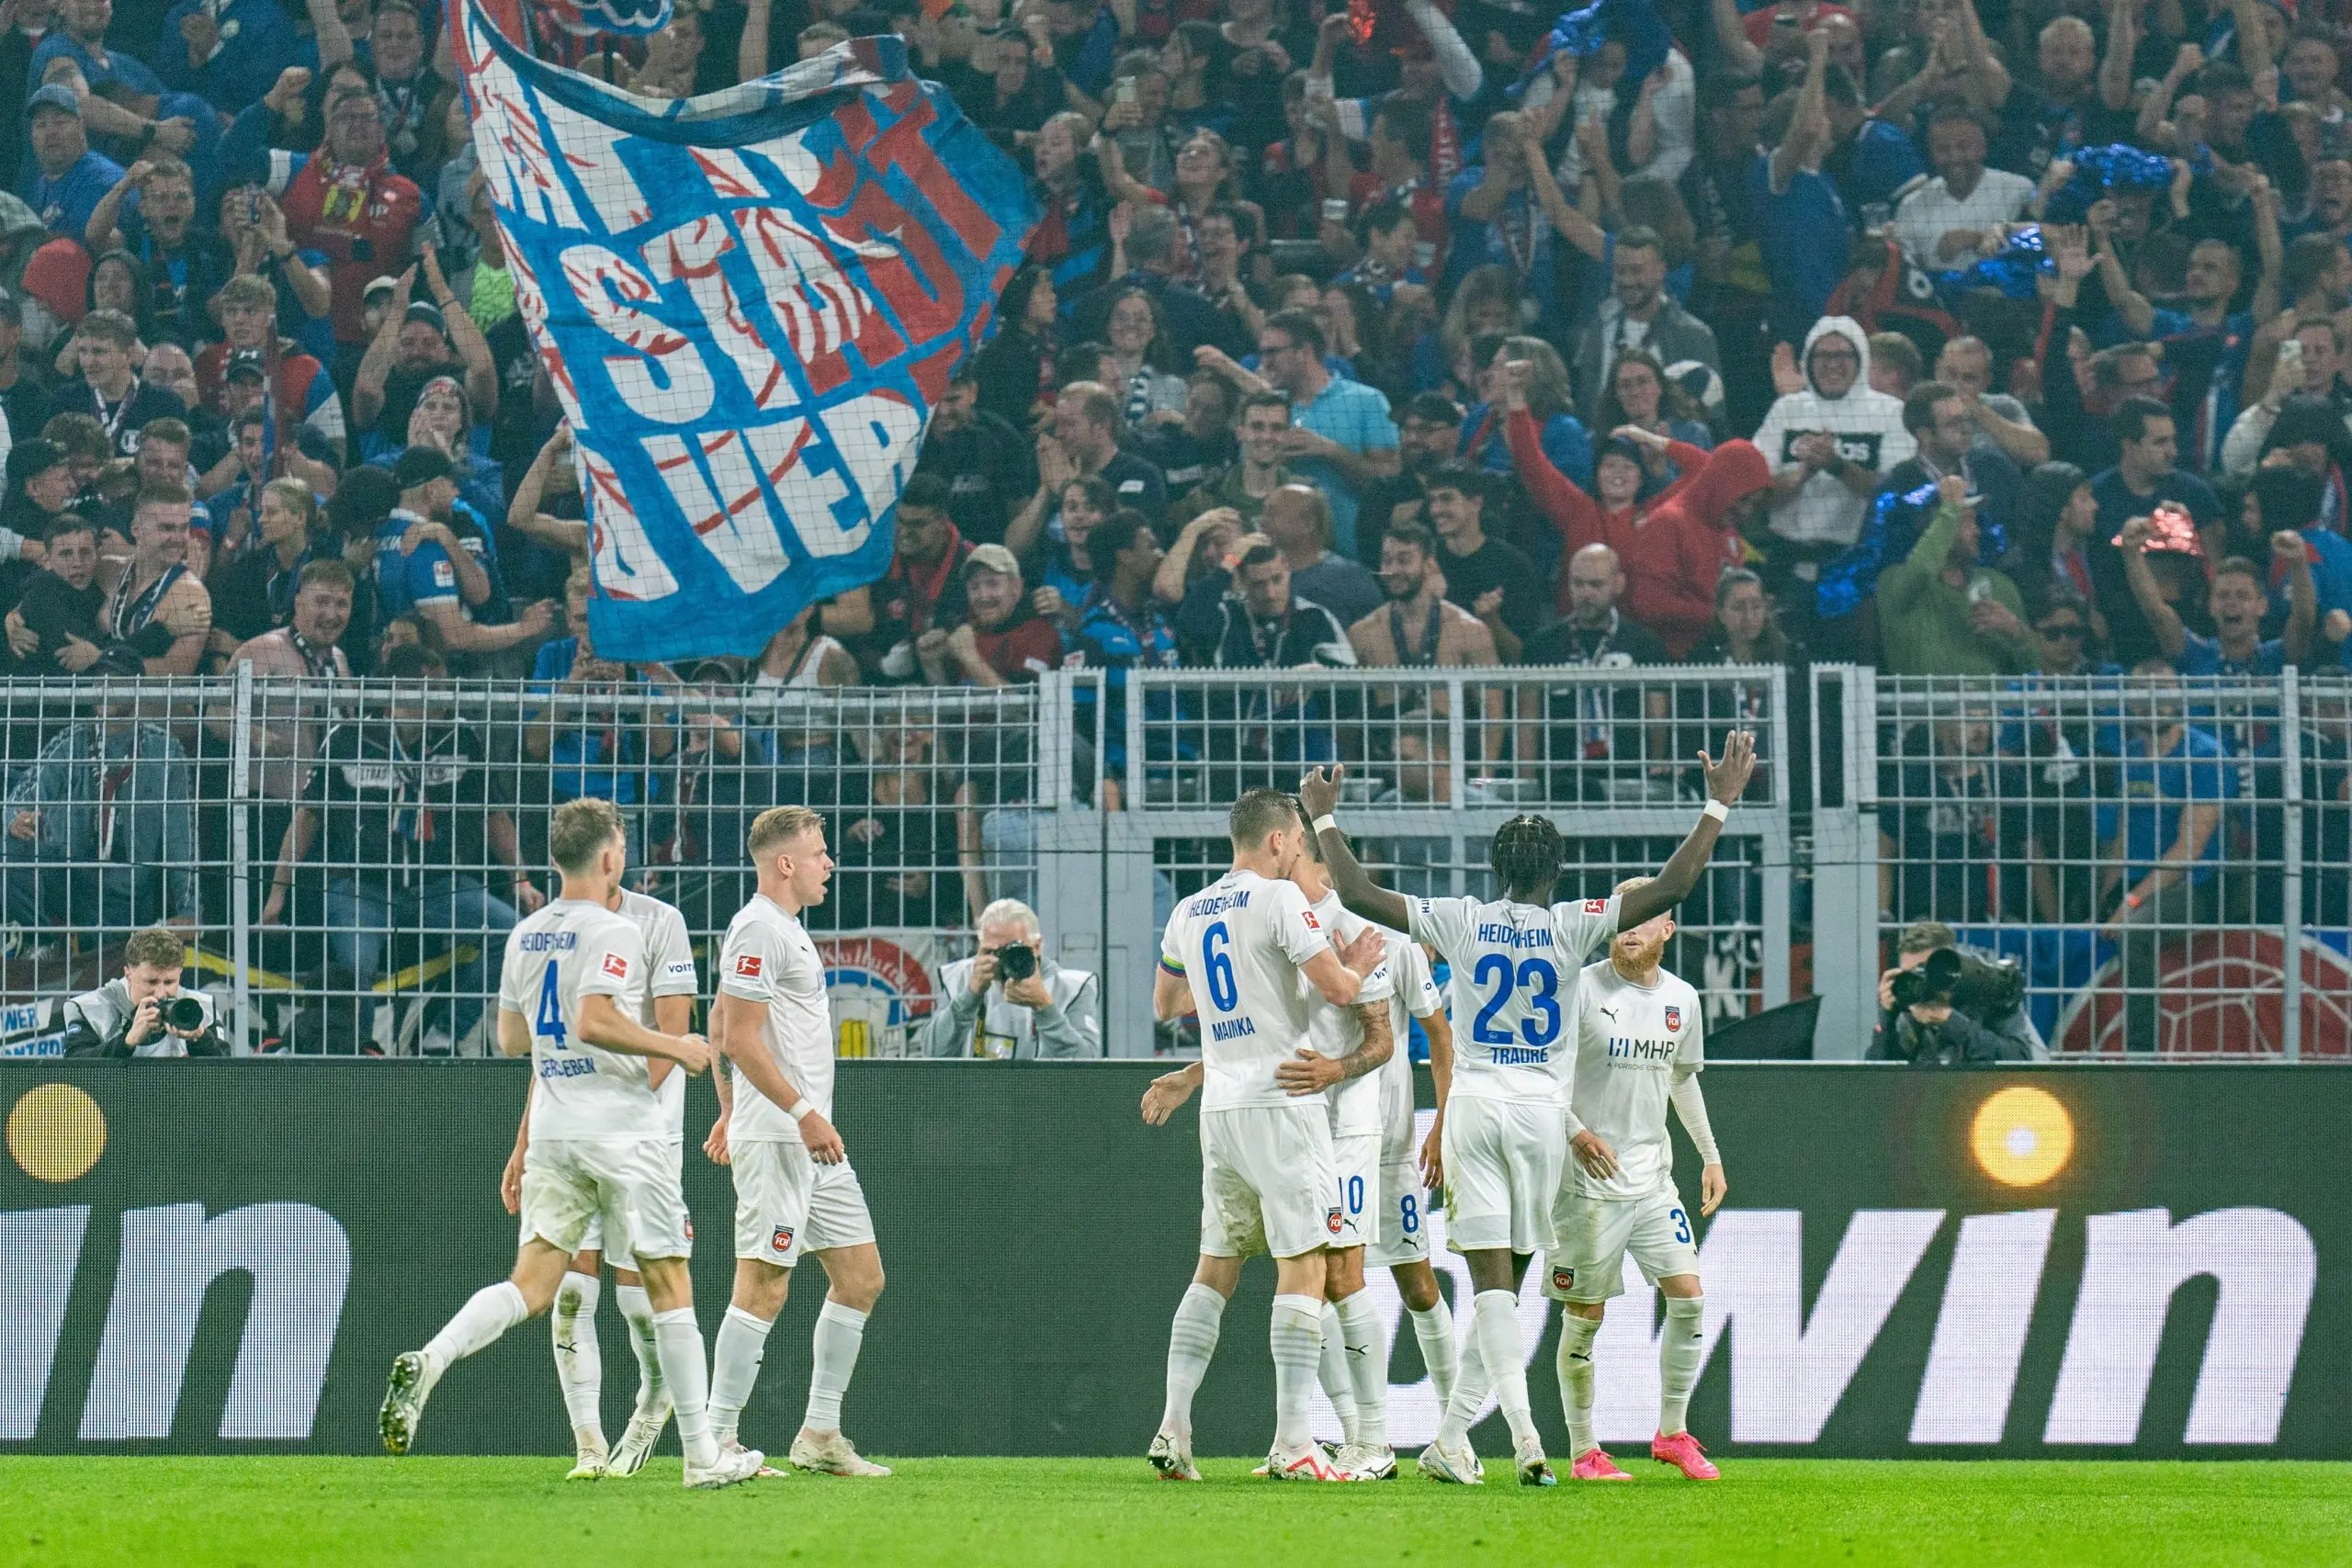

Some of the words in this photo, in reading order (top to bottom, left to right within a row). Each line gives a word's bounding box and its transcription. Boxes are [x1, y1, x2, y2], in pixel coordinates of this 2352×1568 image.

[1477, 922, 1554, 949] HEIDNHEIM
[1202, 920, 1238, 1012] 6
[537, 959, 567, 1050] 4
[1473, 953, 1561, 1046] 23
[1211, 1017, 1256, 1042] MAINKA
[1634, 1039, 1675, 1060] MHP
[1400, 1194, 1419, 1234] 8
[1669, 1199, 1691, 1244] 3
